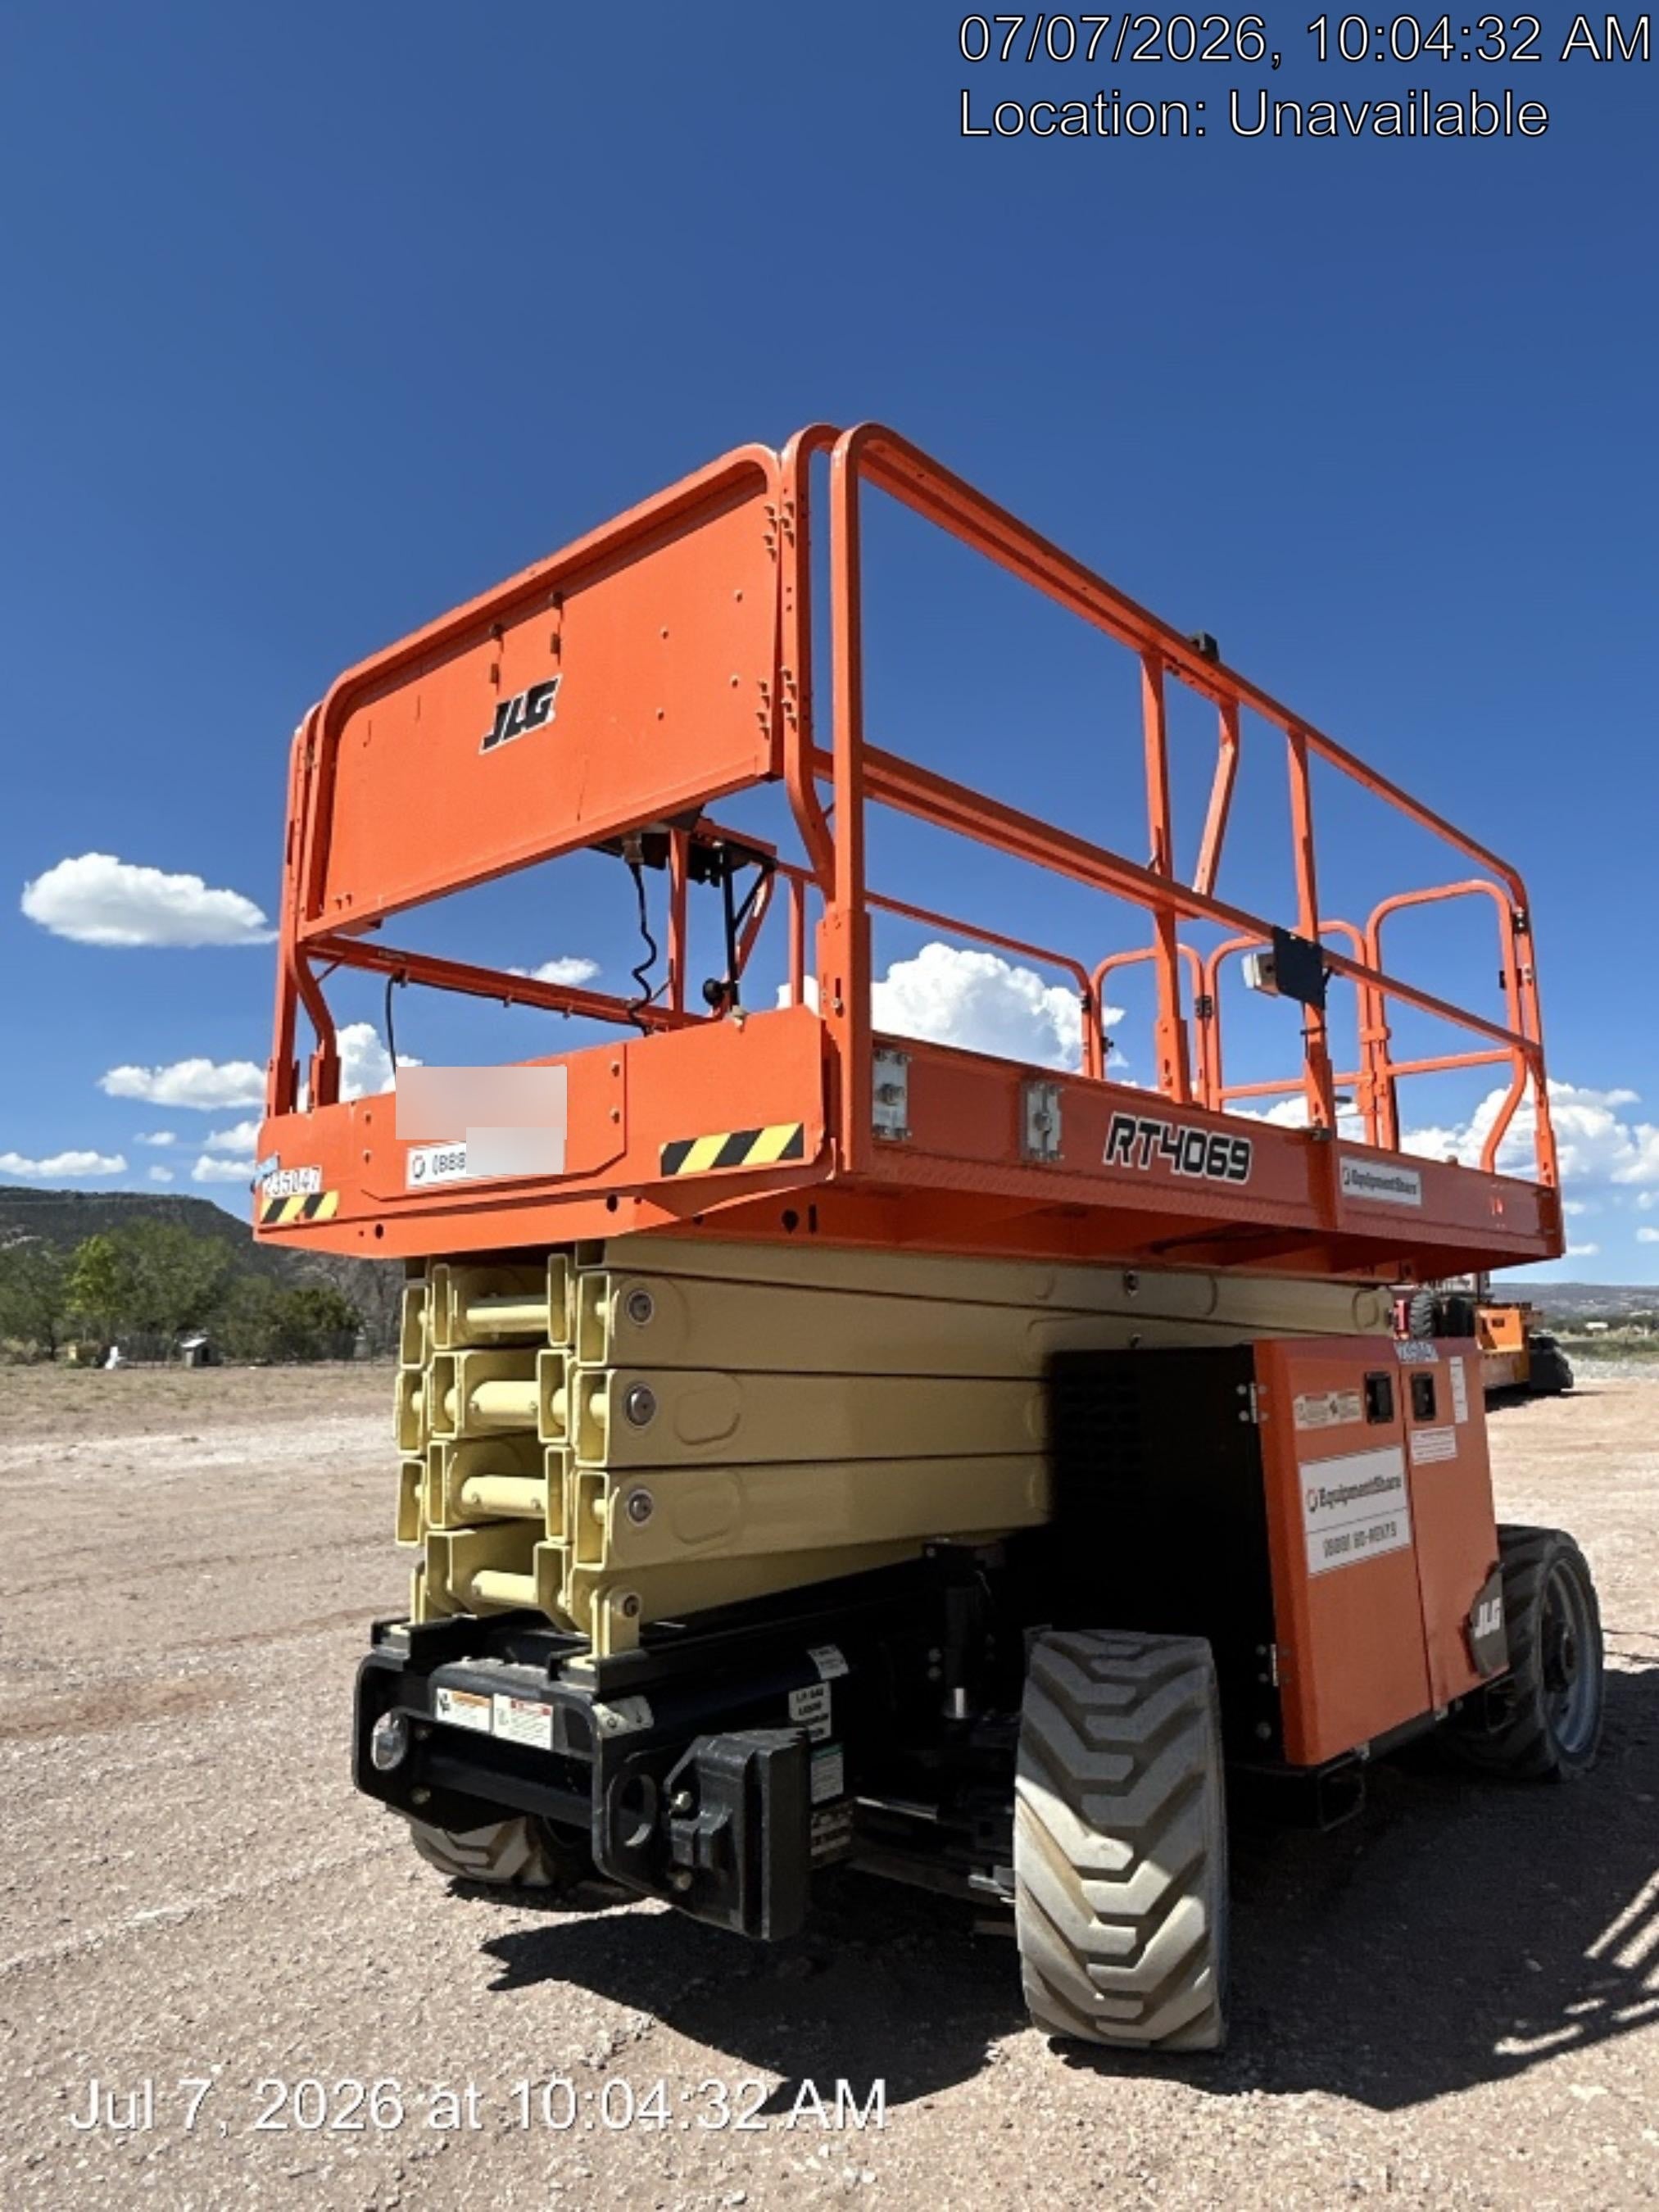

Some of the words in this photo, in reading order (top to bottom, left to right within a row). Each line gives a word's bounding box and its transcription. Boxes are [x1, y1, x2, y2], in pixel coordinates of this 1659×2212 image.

[480, 674, 562, 753] JLG
[1103, 1112, 1252, 1185] RT4069
[1474, 1597, 1501, 1639] JLG
